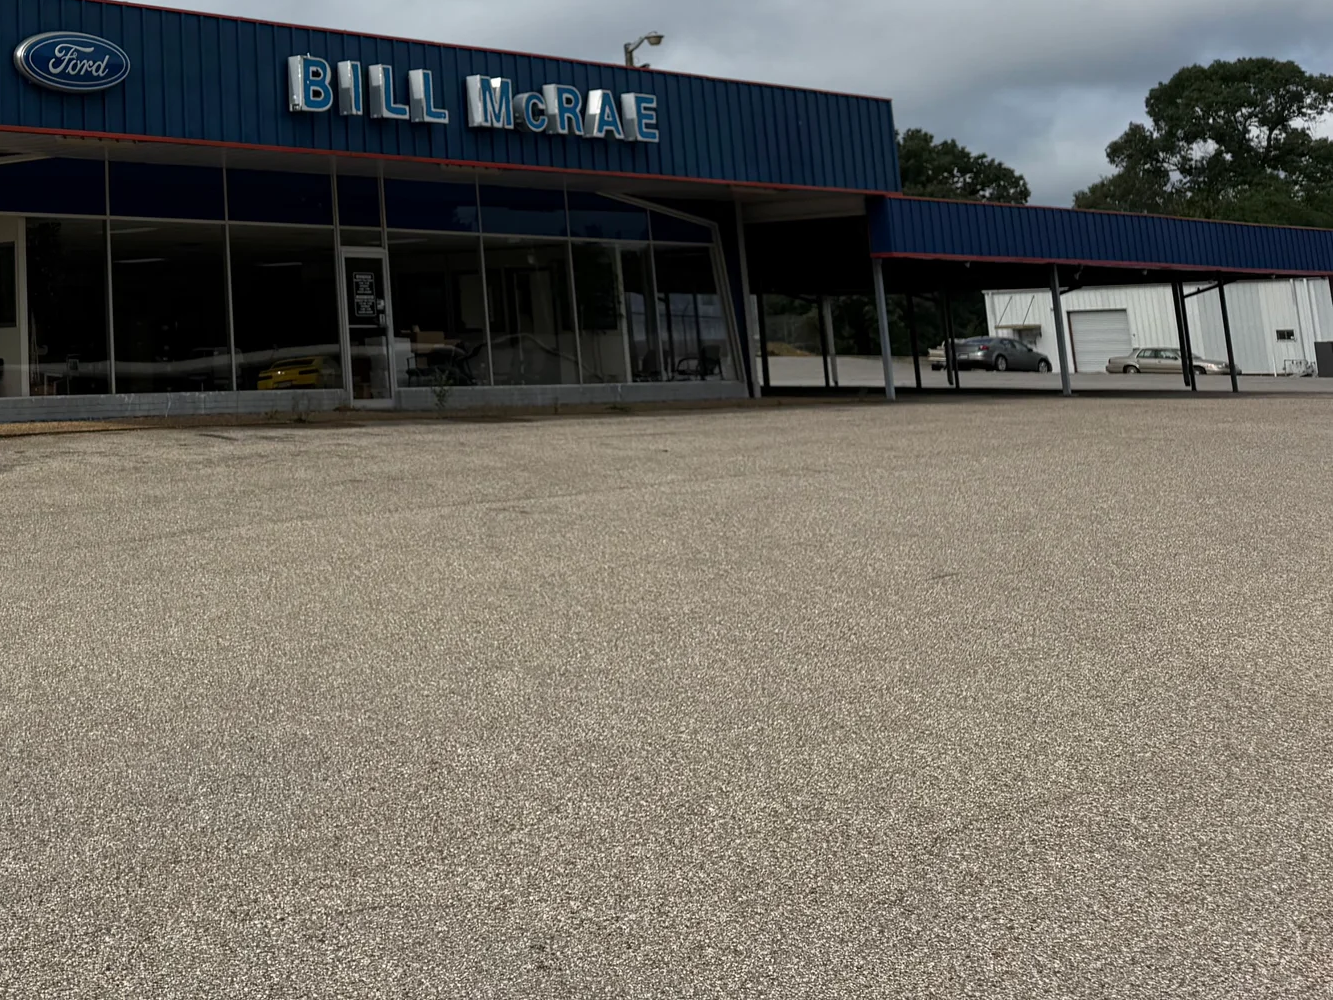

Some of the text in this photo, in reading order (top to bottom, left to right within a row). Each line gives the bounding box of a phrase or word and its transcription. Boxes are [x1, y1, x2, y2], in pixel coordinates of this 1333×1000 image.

[48, 43, 110, 77] Ford
[288, 54, 659, 143] BILL McRAE
